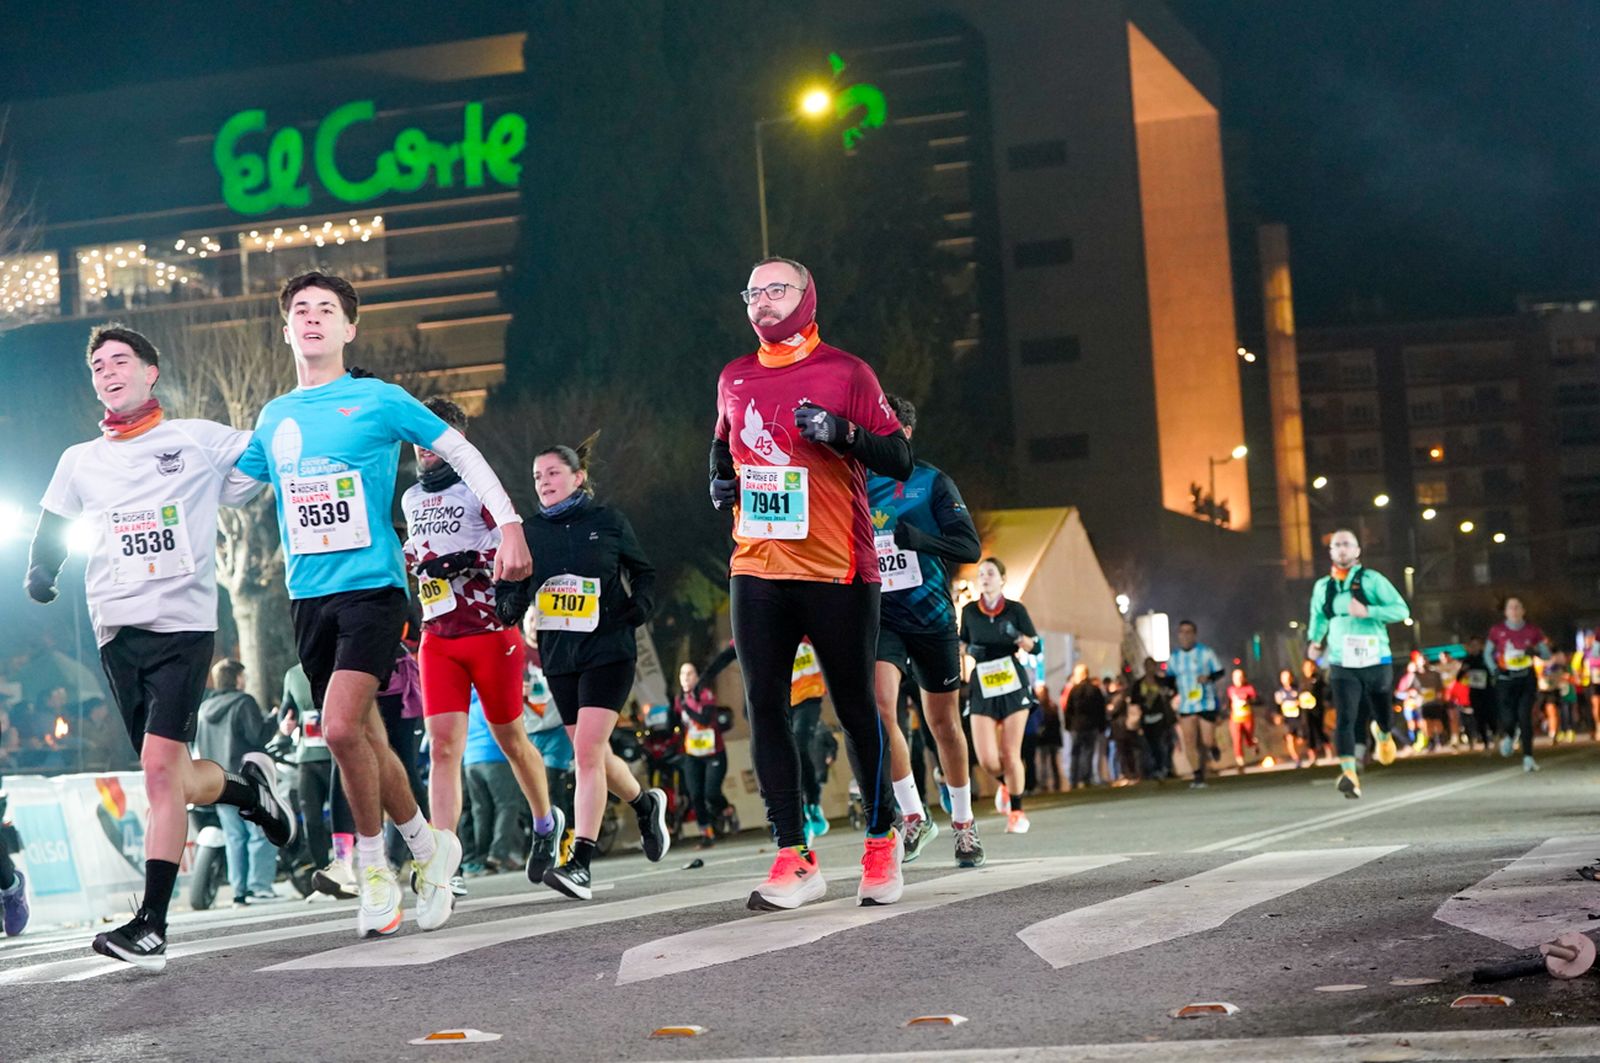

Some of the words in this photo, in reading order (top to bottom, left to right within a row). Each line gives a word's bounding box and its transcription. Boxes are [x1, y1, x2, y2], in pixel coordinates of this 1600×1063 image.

[214, 109, 310, 214] El
[315, 100, 526, 202] Corte
[754, 436, 773, 456] 43
[320, 482, 329, 491] DE
[422, 496, 443, 508] CLUB
[751, 491, 790, 514] 7941
[147, 511, 156, 520] DE
[298, 500, 350, 527] 3539
[412, 506, 465, 523] TLETISMO
[412, 520, 461, 536] ONTORO
[121, 528, 176, 556] 3538
[879, 553, 907, 573] 826
[552, 594, 585, 611] 7107
